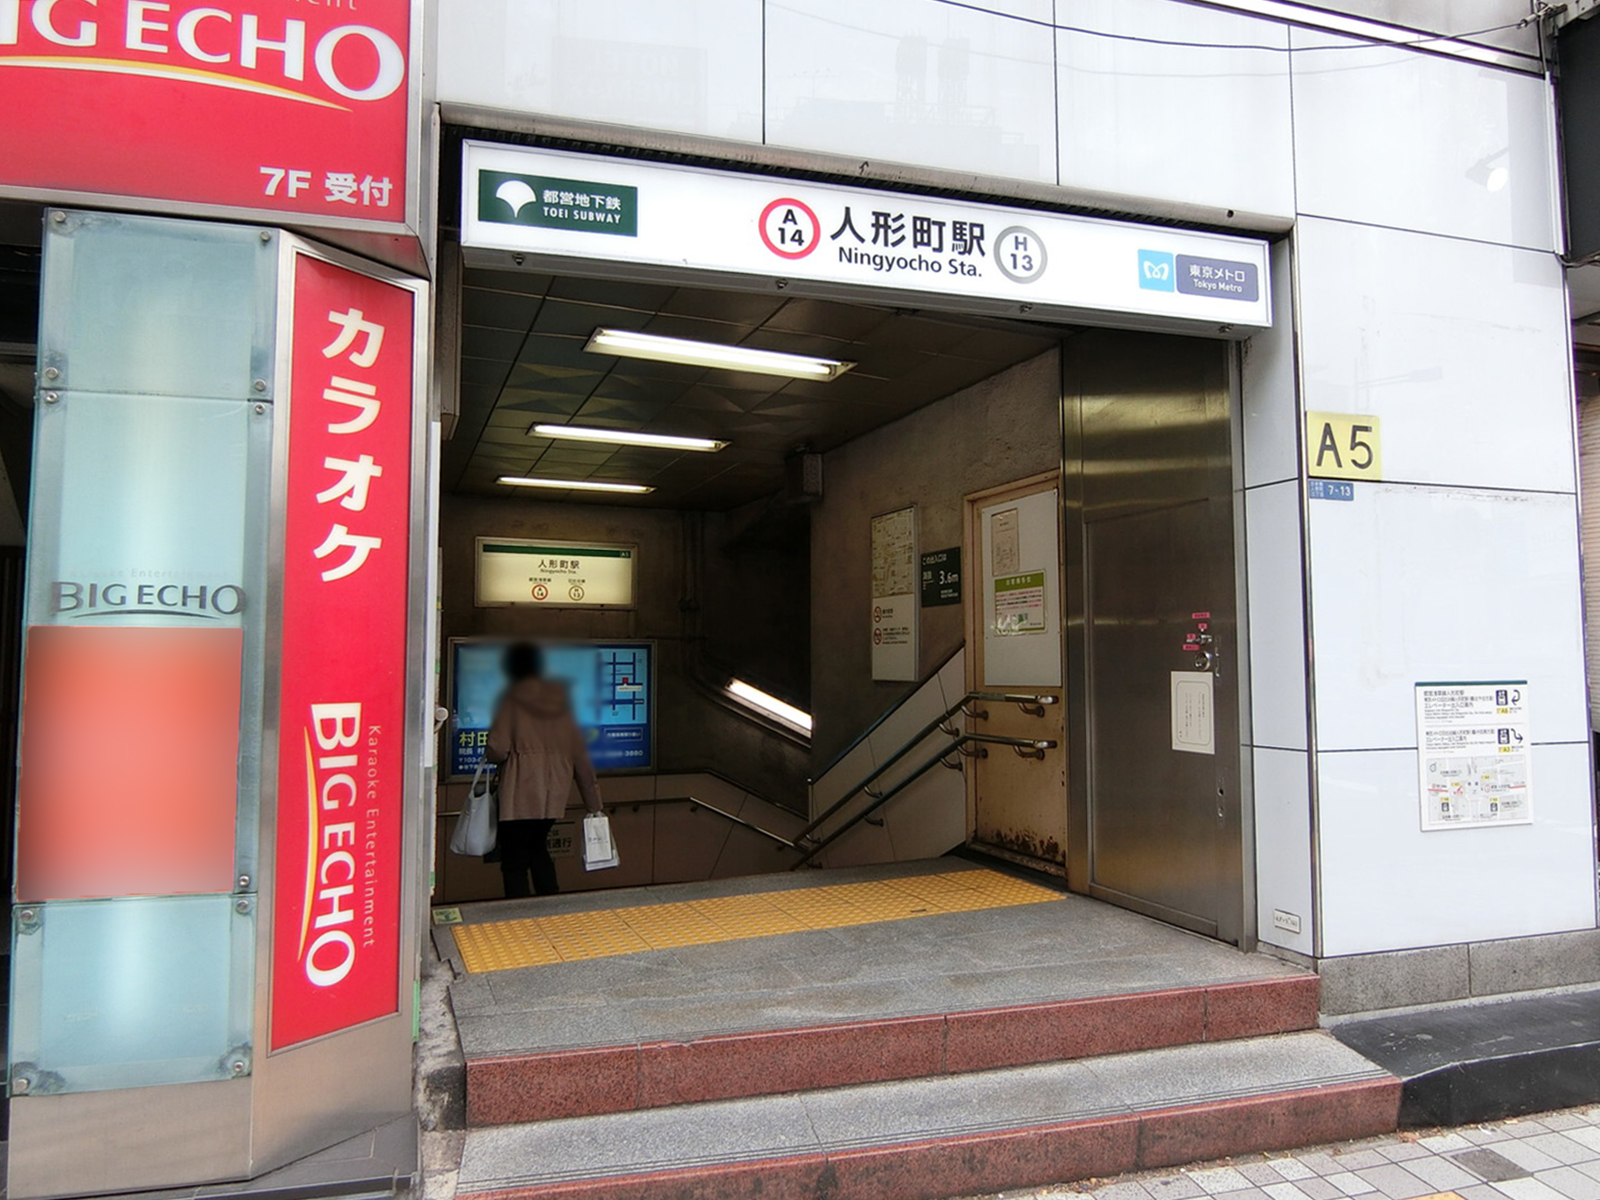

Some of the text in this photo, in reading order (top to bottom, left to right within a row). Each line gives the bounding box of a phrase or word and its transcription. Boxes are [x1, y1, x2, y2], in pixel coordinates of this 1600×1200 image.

[0, 0, 405, 102] IG ECHO
[259, 165, 394, 208] 7F 受付
[542, 188, 622, 211] 都営地下鉄
[542, 205, 622, 225] TOEI SUBWAY
[782, 206, 799, 226] A
[776, 226, 805, 247] 14
[829, 206, 987, 258] 人形町駅
[1014, 235, 1028, 251] H
[838, 245, 983, 278] Ningyocho Sta.
[1009, 251, 1035, 273] 13
[1188, 263, 1247, 284] 東京メトロ
[1192, 277, 1244, 293] Tokyo Metro
[312, 307, 385, 583] カラオケ
[1315, 421, 1374, 470] A5
[1327, 484, 1352, 498] 7-13
[537, 559, 581, 570] 人形町駅
[938, 570, 959, 585] 3.6m
[50, 581, 248, 615] BIG ECHO
[304, 702, 362, 988] BIG ECHO
[361, 724, 382, 948] Karaoke Entertainment
